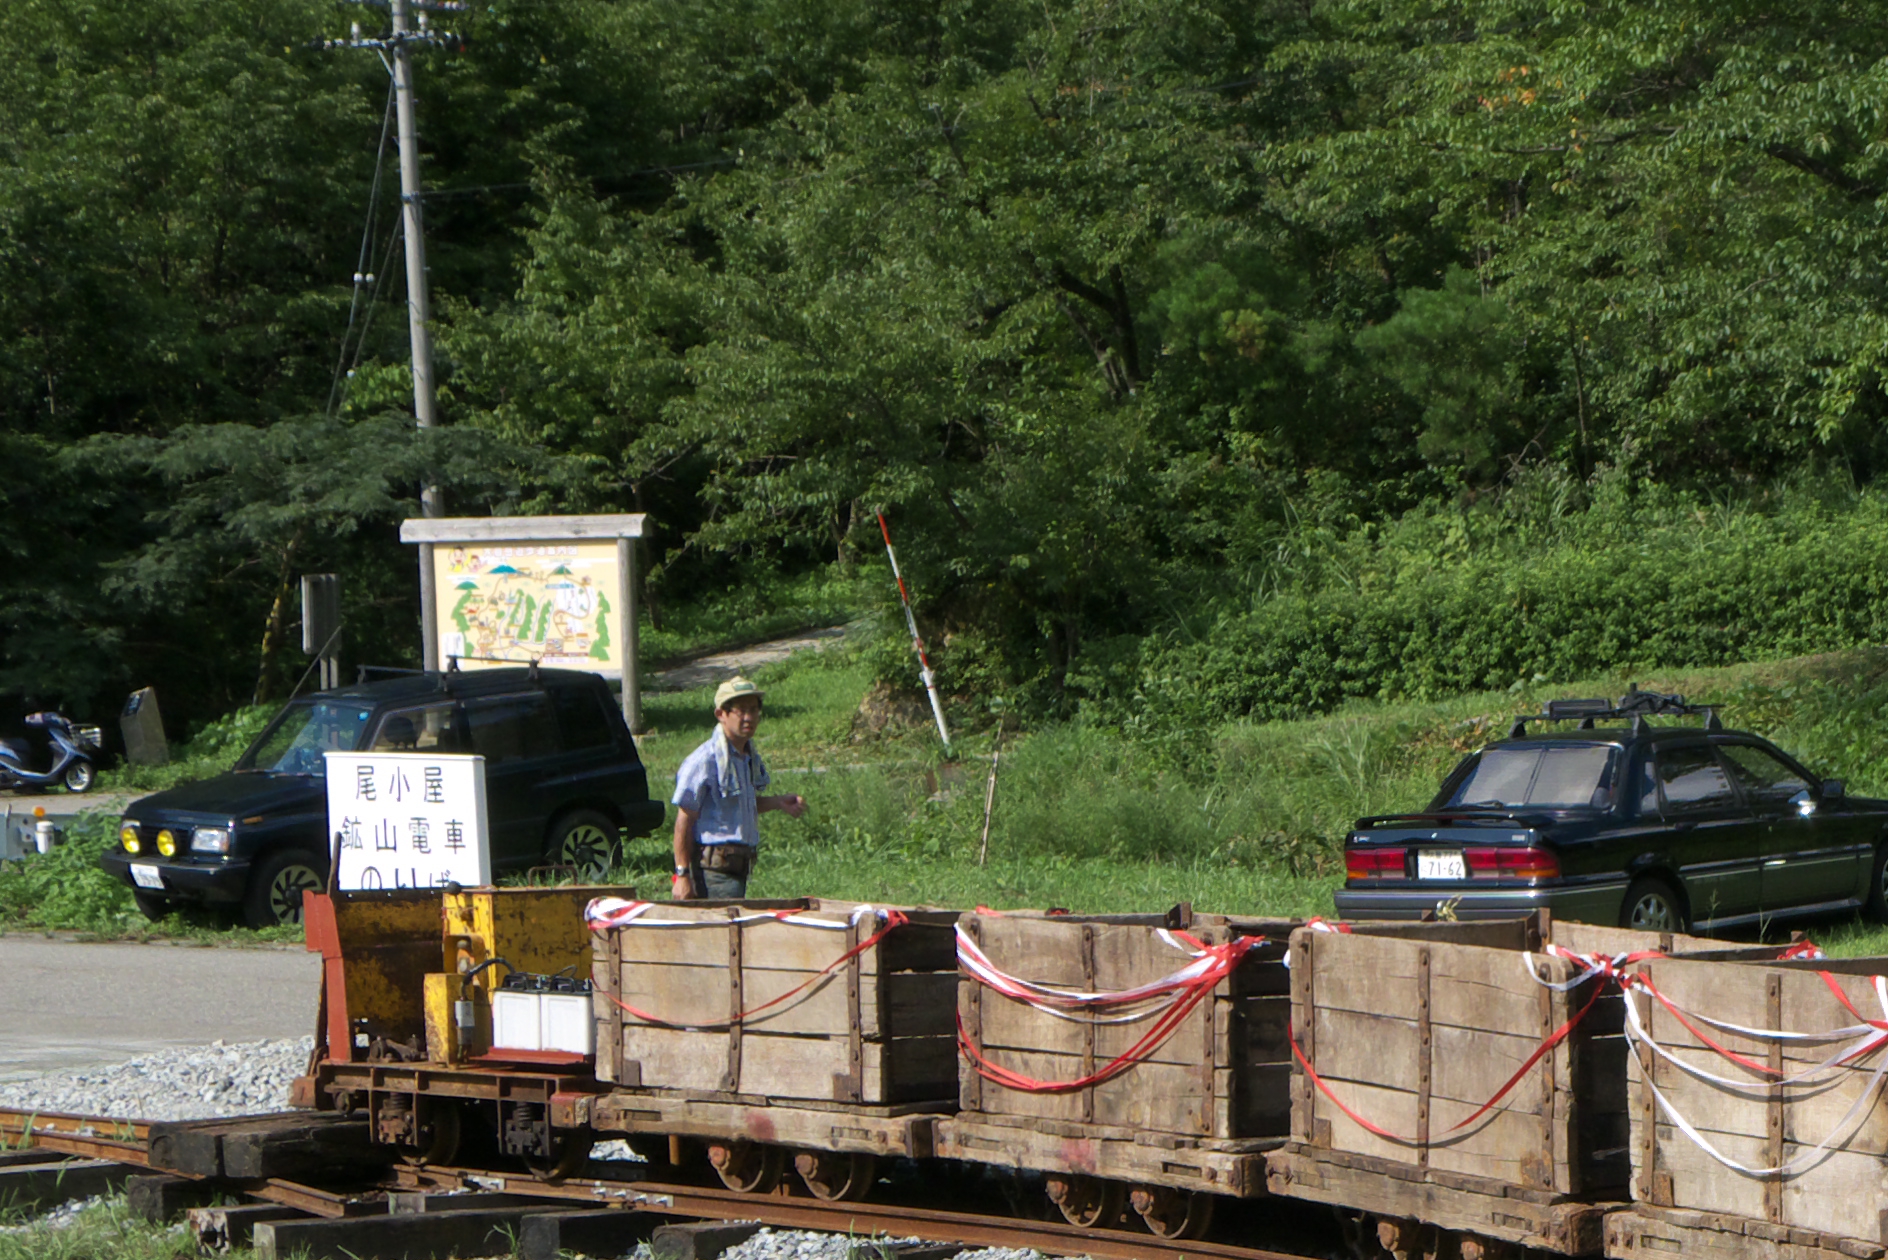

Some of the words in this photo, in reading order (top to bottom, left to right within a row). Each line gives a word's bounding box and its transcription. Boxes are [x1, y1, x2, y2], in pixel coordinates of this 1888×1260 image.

[356, 765, 445, 803] 尾小屋
[341, 816, 466, 854] 鉱山電車
